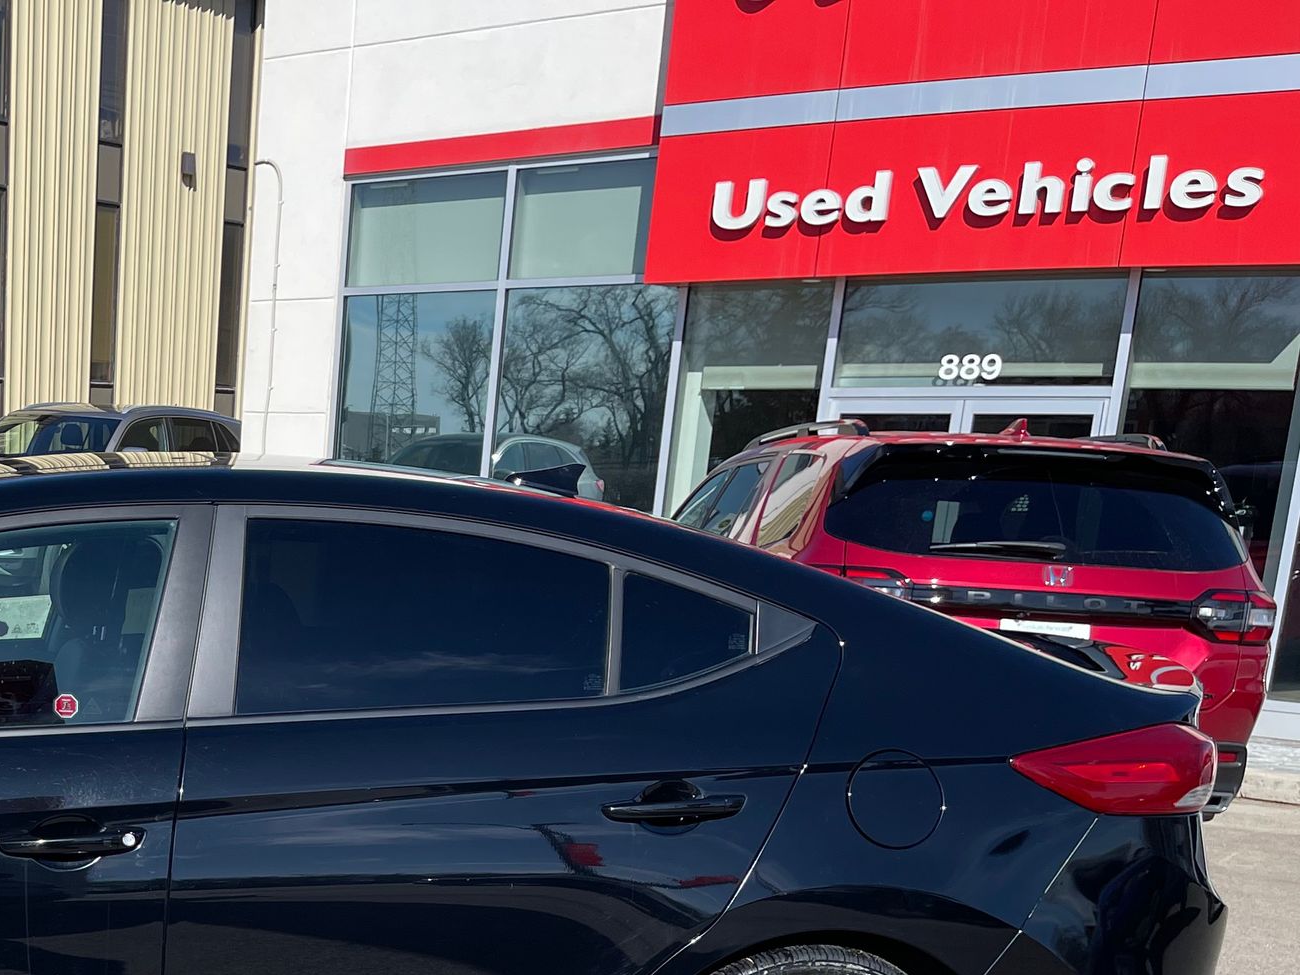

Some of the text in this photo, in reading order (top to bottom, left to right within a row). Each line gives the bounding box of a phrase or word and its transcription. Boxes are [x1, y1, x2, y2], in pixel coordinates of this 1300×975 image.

[710, 154, 1266, 231] Used Vehicles
[938, 353, 1003, 380] 889
[966, 590, 1147, 612] PILOT
